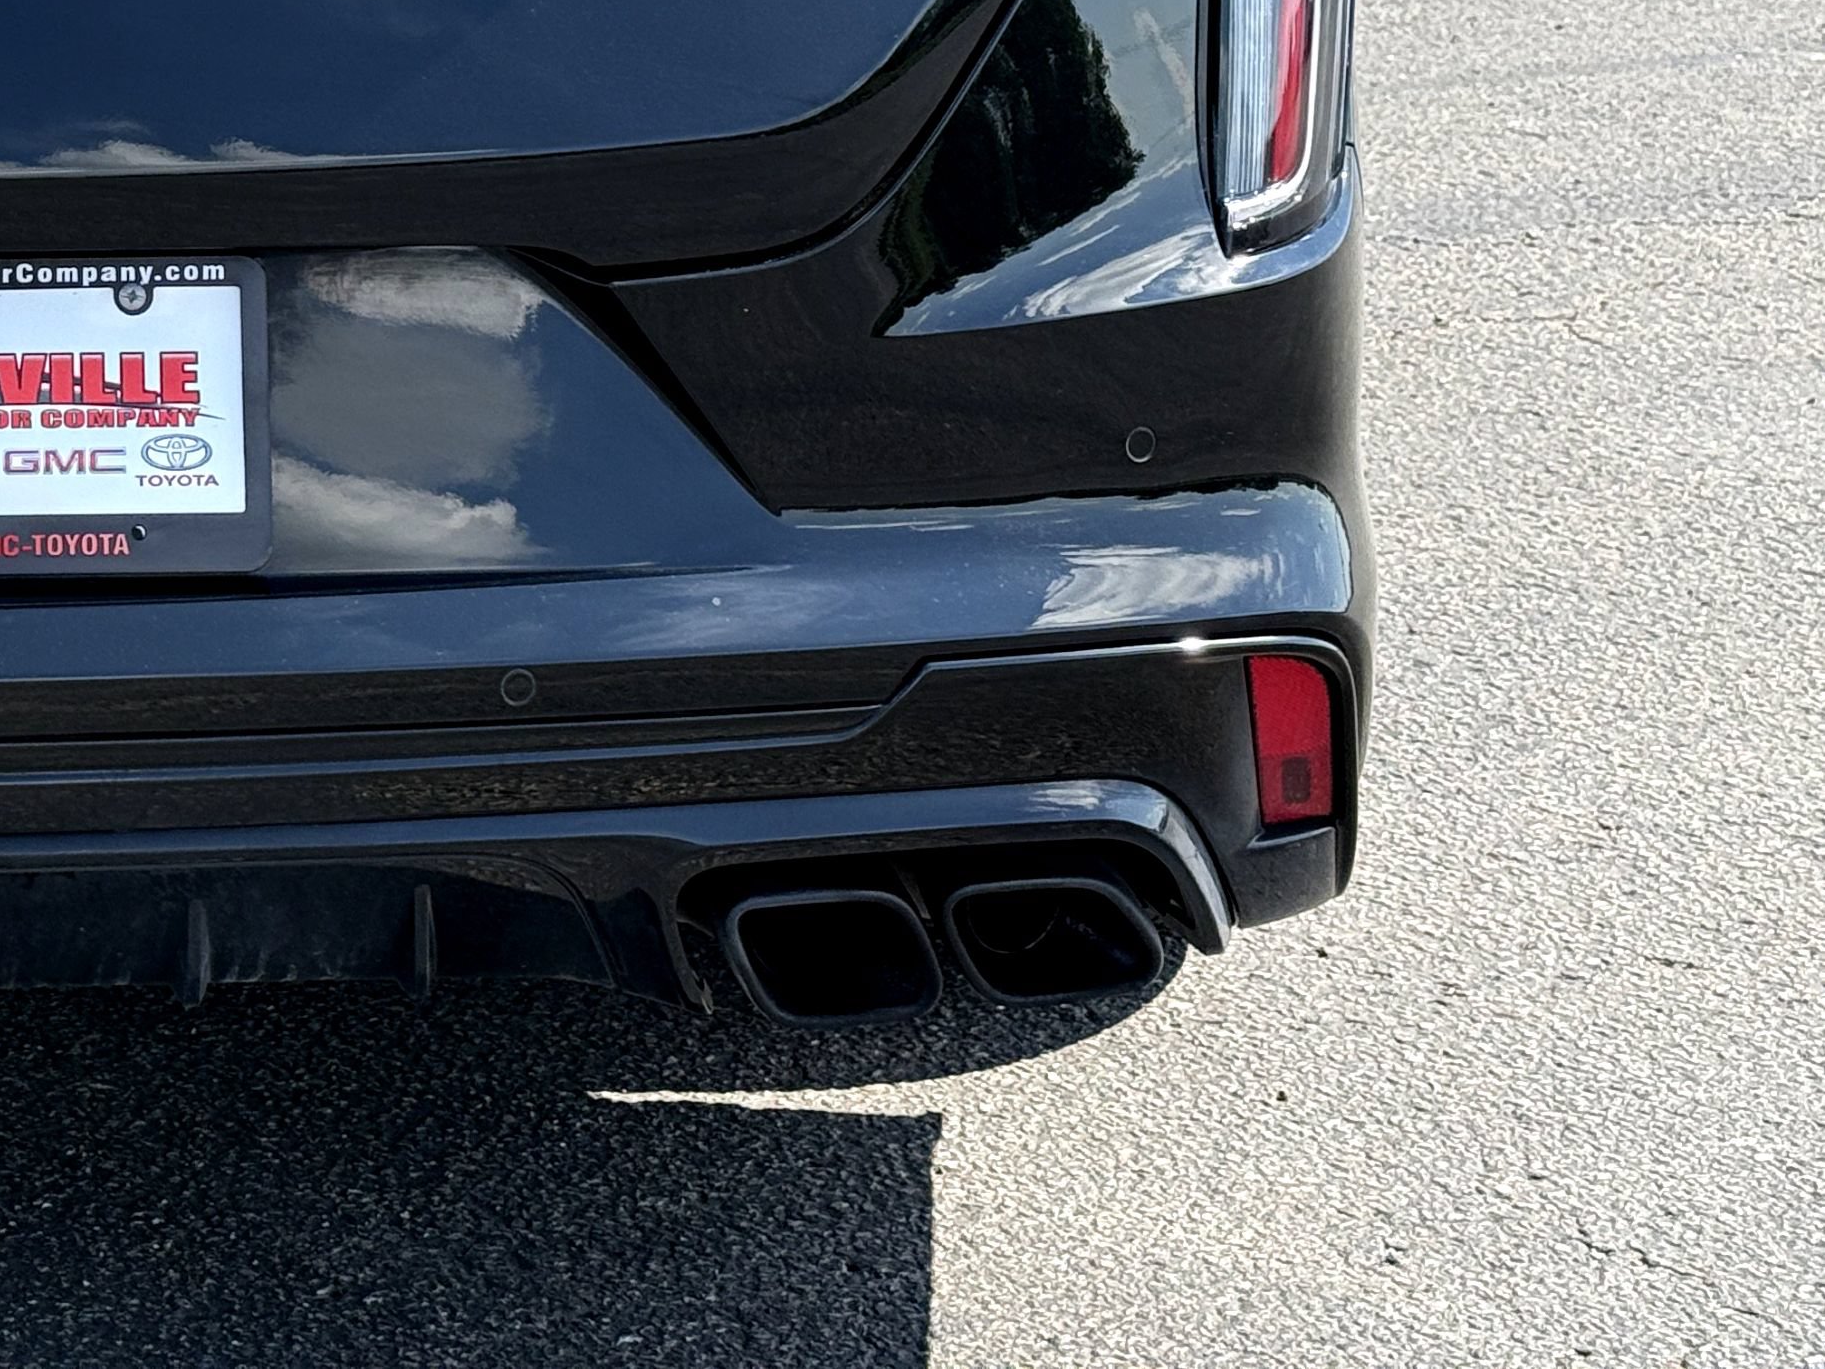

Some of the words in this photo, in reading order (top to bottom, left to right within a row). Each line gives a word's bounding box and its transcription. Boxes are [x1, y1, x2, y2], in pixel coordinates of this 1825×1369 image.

[40, 407, 200, 428] COMPANY
[3, 447, 127, 474] GMC
[135, 474, 219, 487] TOYOTA
